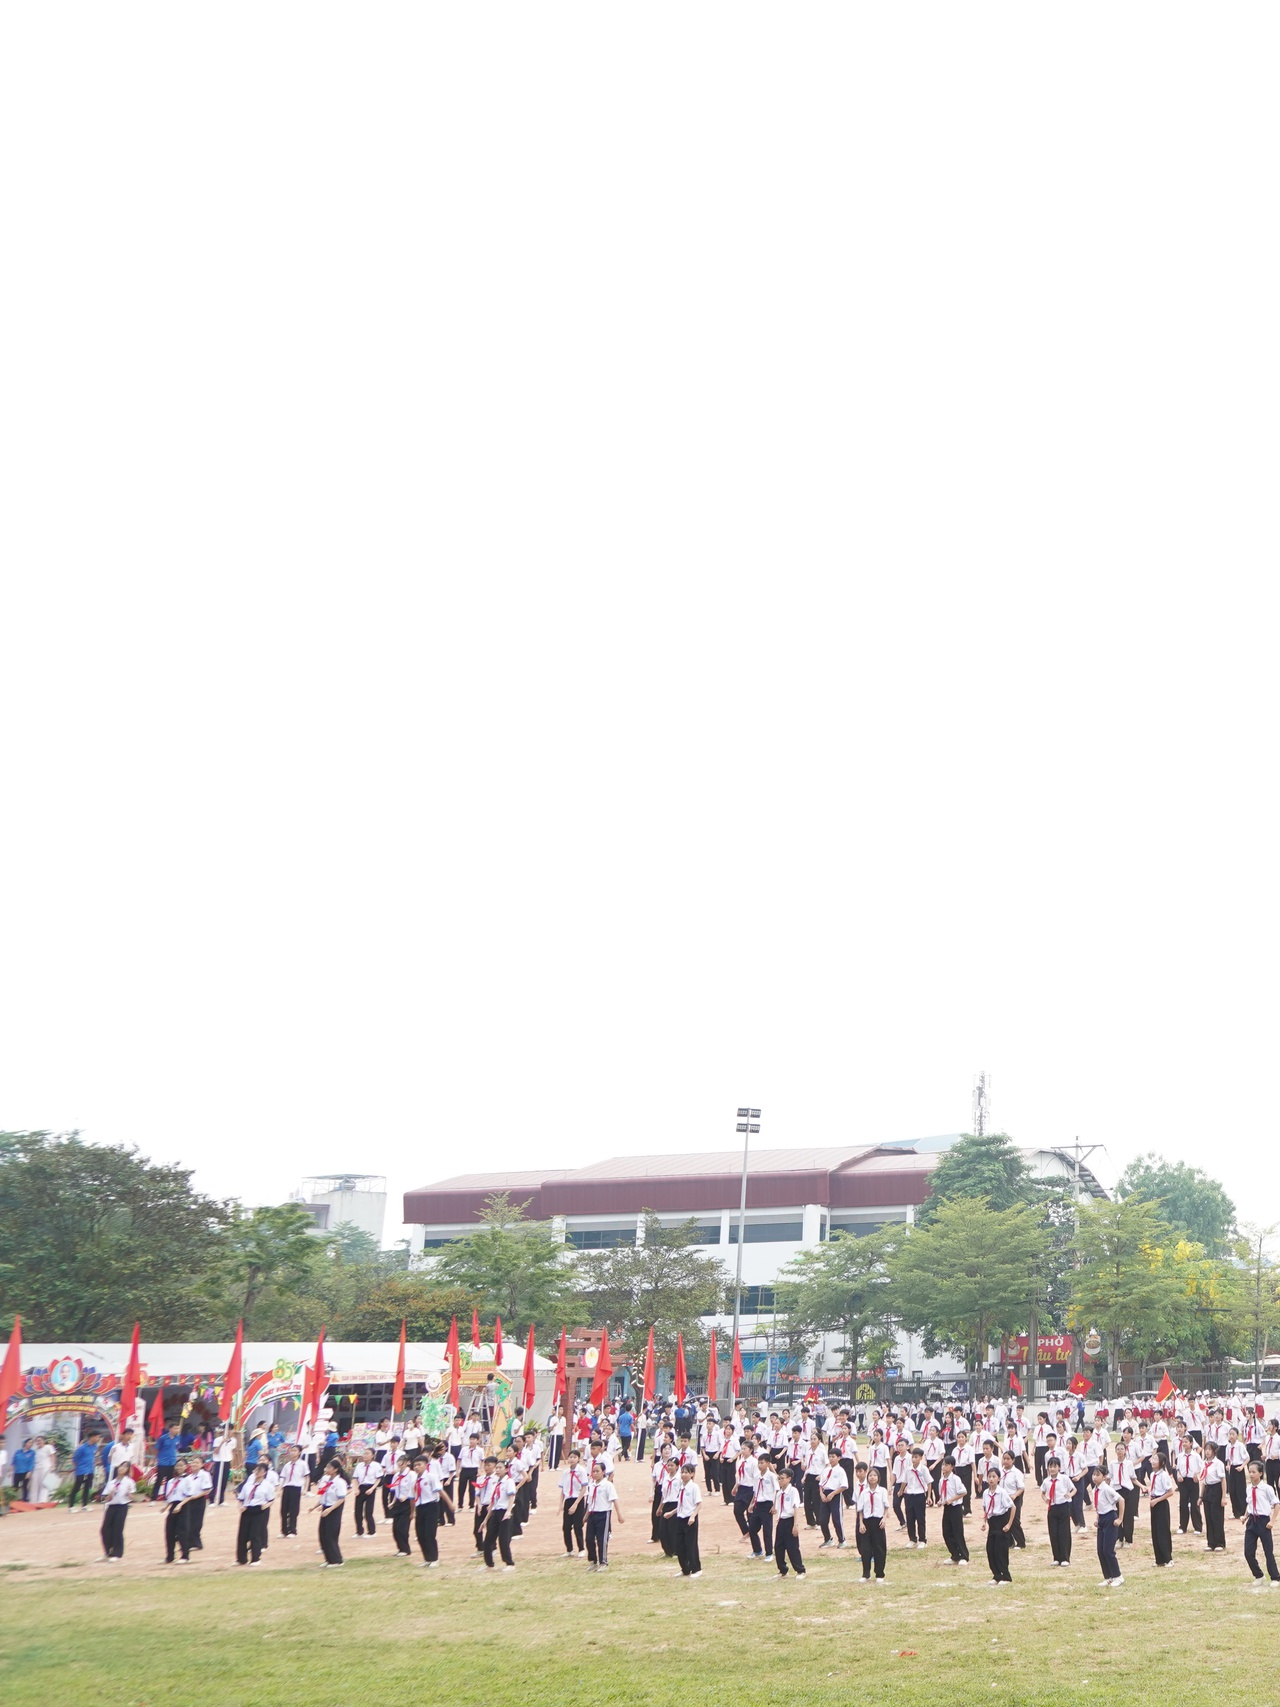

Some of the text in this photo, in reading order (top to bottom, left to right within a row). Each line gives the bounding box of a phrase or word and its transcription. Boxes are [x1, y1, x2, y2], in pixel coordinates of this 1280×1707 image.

[1038, 1336, 1064, 1347] PHỞ
[1021, 1346, 1053, 1362] Tâu
[273, 1358, 295, 1381] 85
